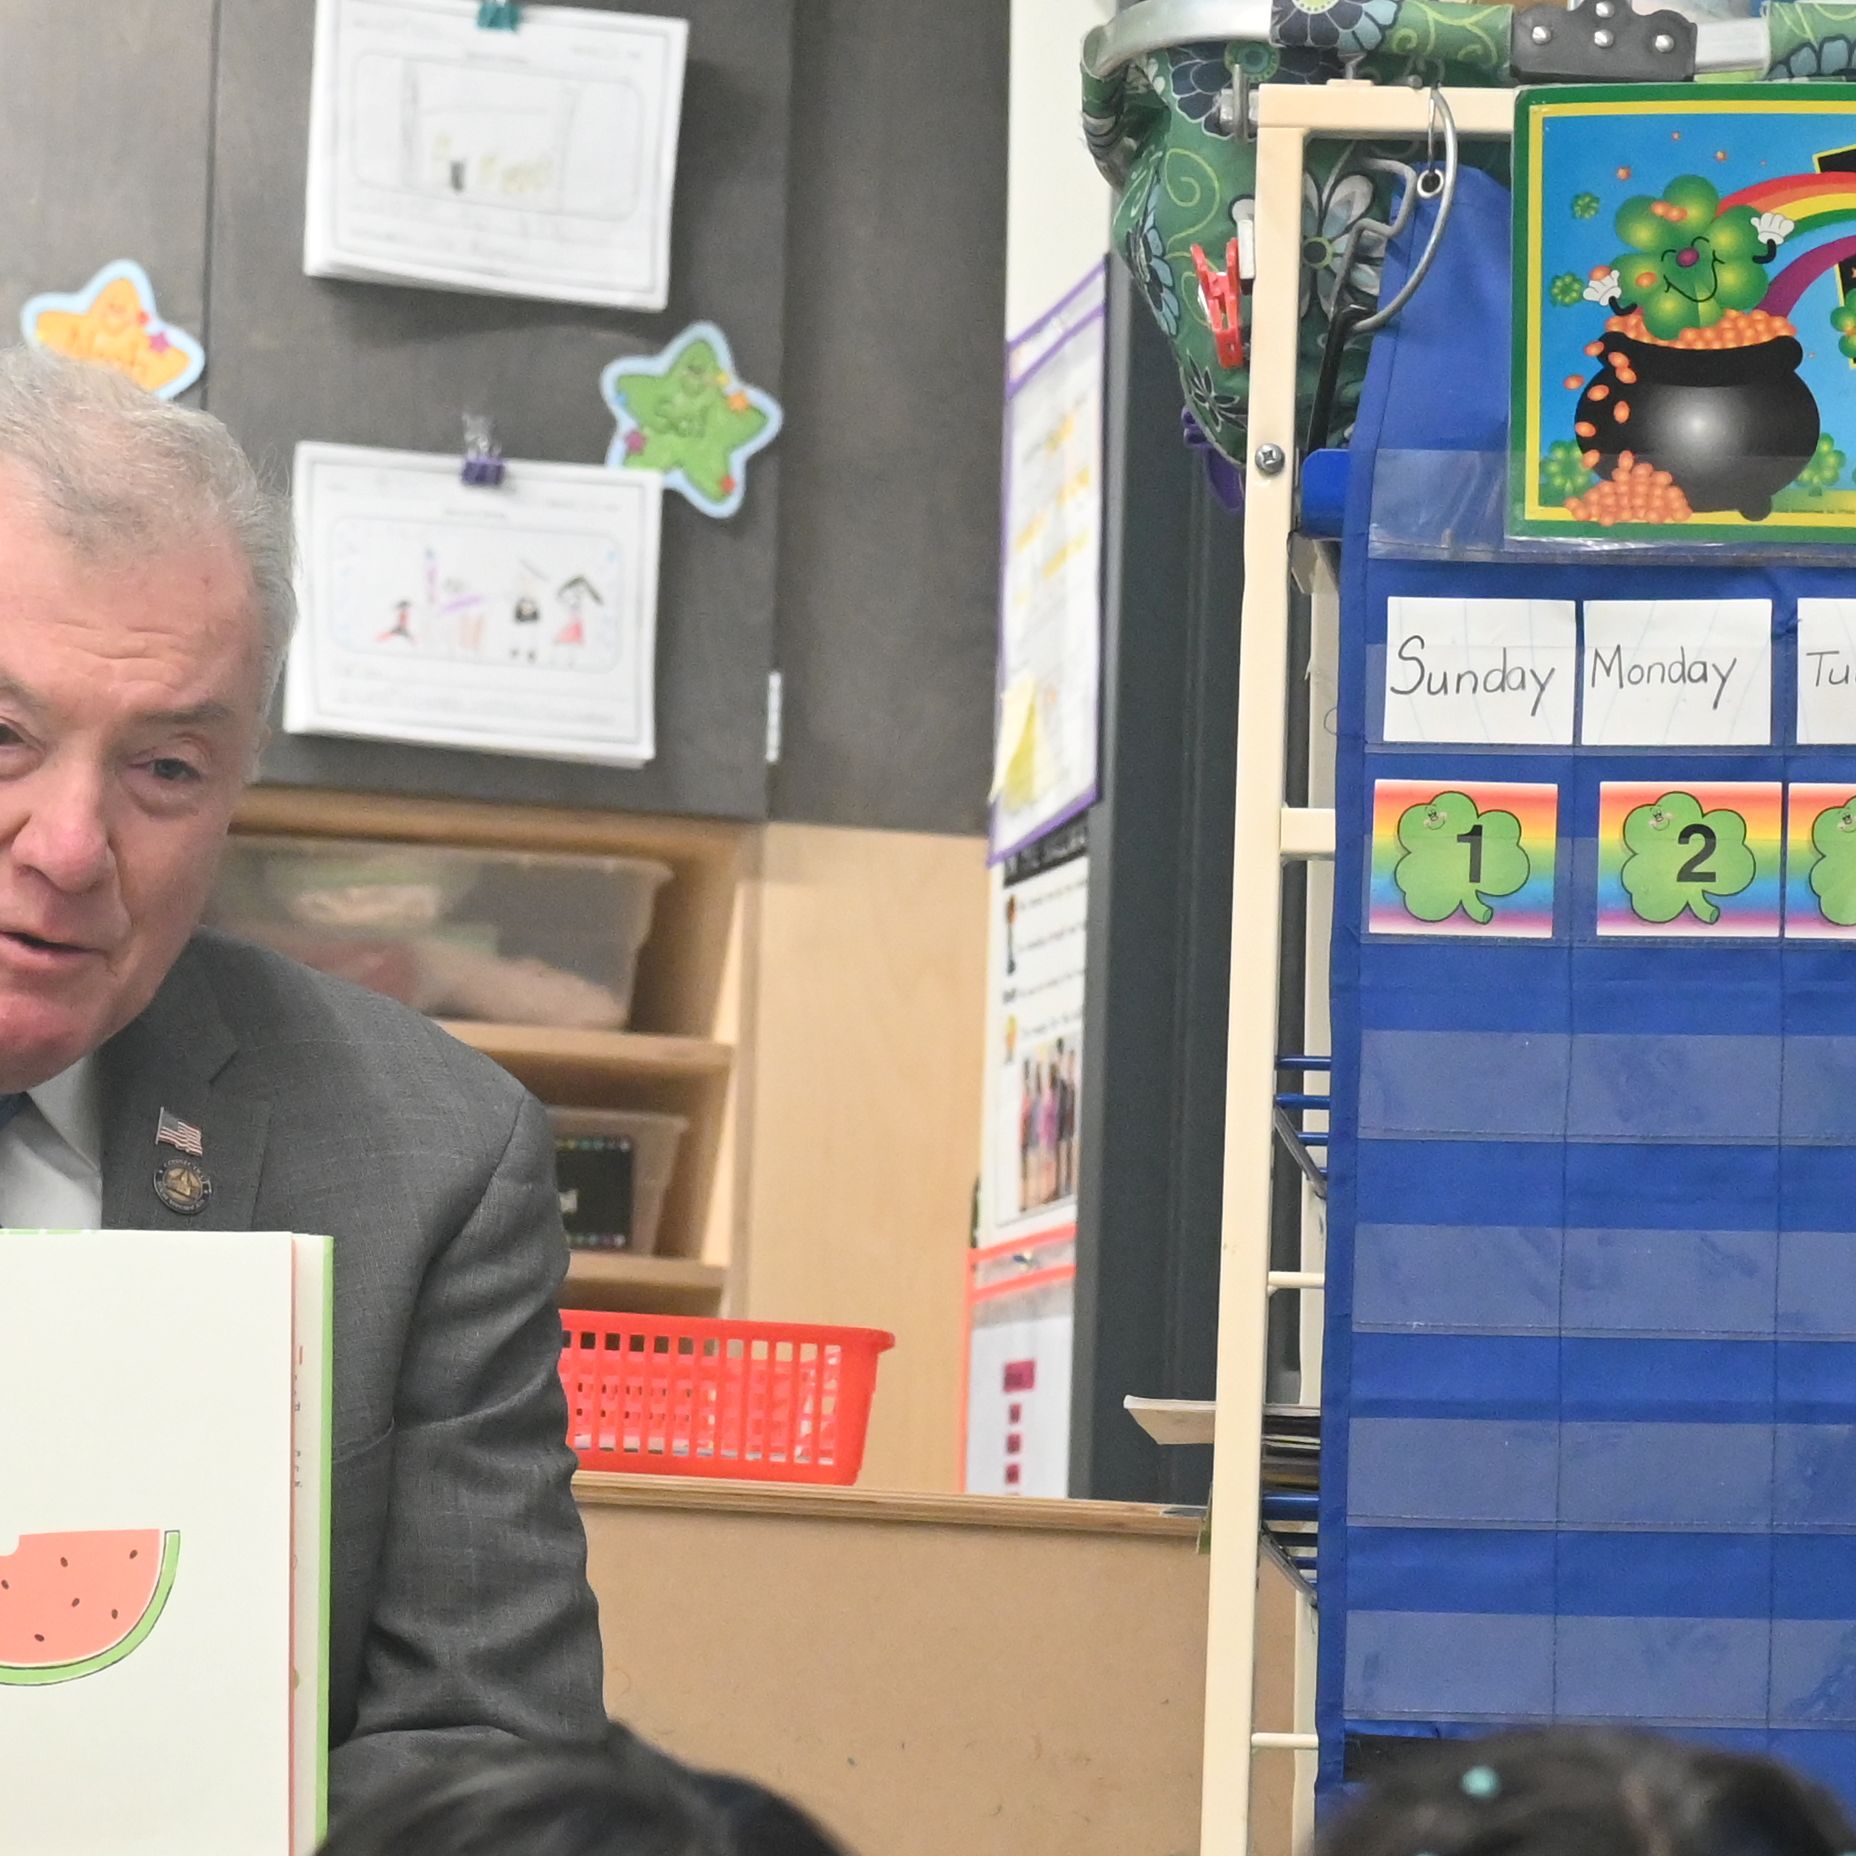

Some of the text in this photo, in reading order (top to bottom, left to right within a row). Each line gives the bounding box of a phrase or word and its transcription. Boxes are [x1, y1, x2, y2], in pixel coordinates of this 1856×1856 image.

[1390, 634, 1556, 717] Sunday
[1591, 643, 1738, 711] Monday
[1456, 826, 1486, 885] 1
[1678, 823, 1718, 884] 2
